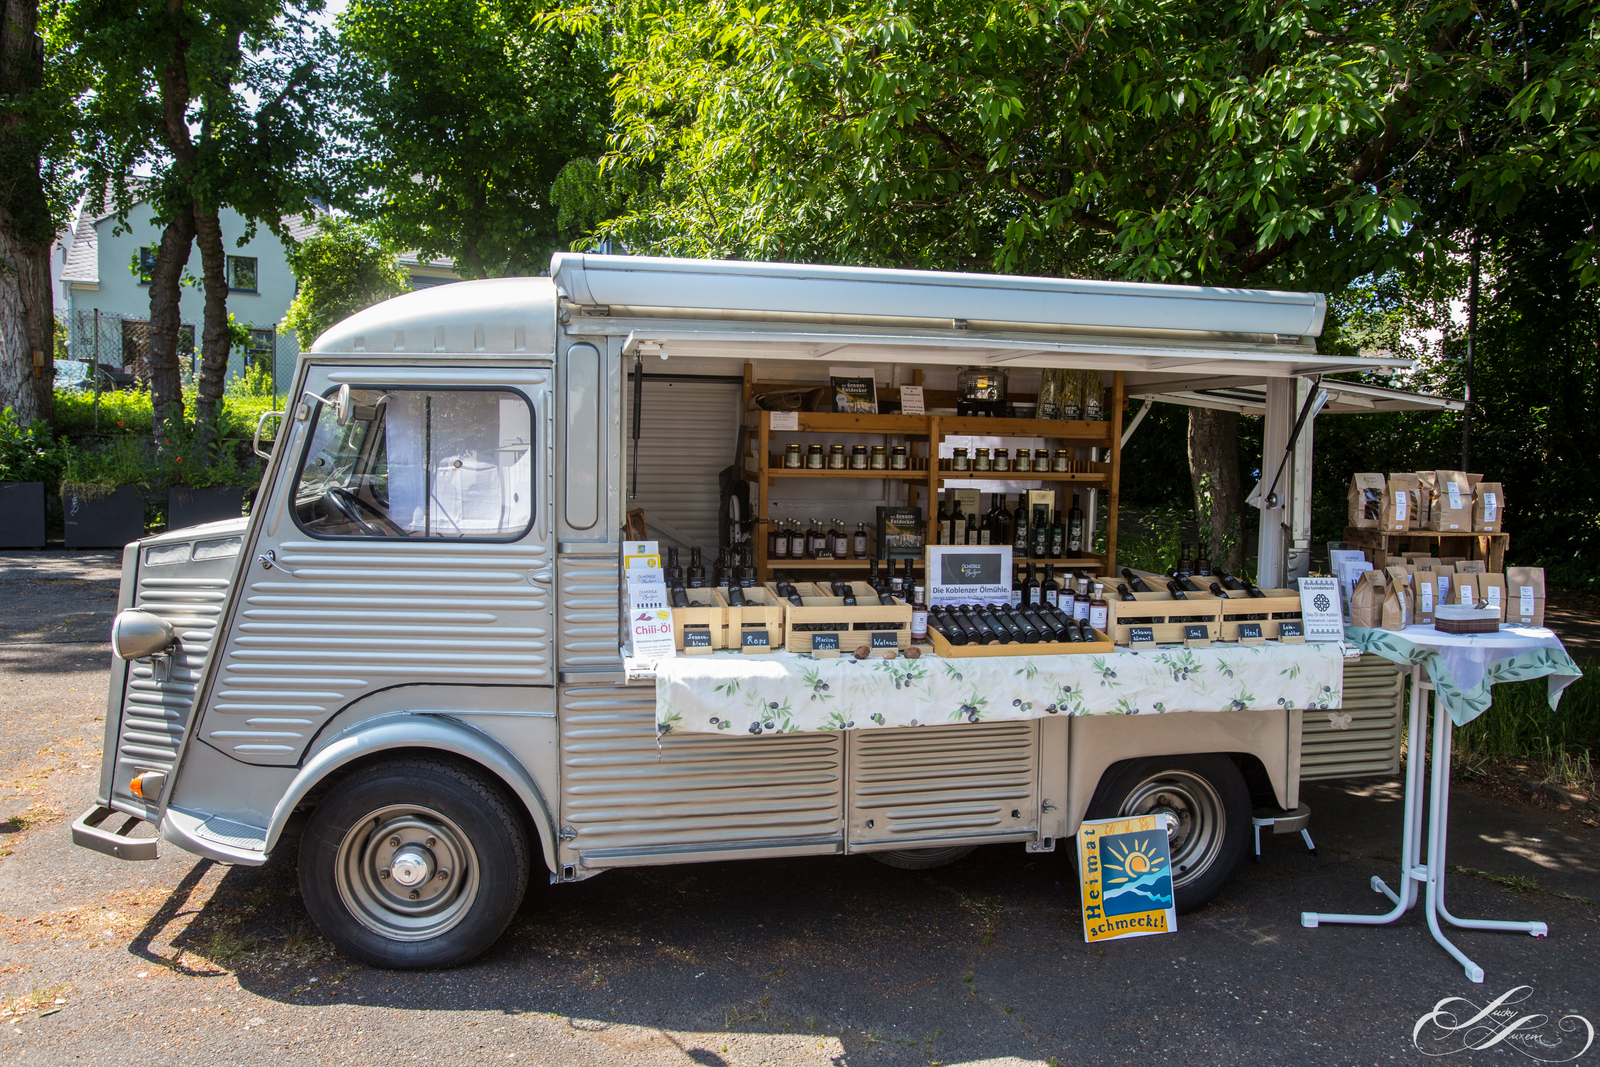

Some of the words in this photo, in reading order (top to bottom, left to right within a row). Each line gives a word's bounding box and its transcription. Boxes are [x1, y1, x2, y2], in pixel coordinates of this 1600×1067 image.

[979, 585, 1010, 593] Ölmühle.
[635, 622, 671, 635] Chili-Öl
[1244, 628, 1259, 637] Hanf
[746, 635, 767, 646] Raps
[1084, 828, 1101, 920] Heimat
[1090, 915, 1164, 937] schmeckt!
